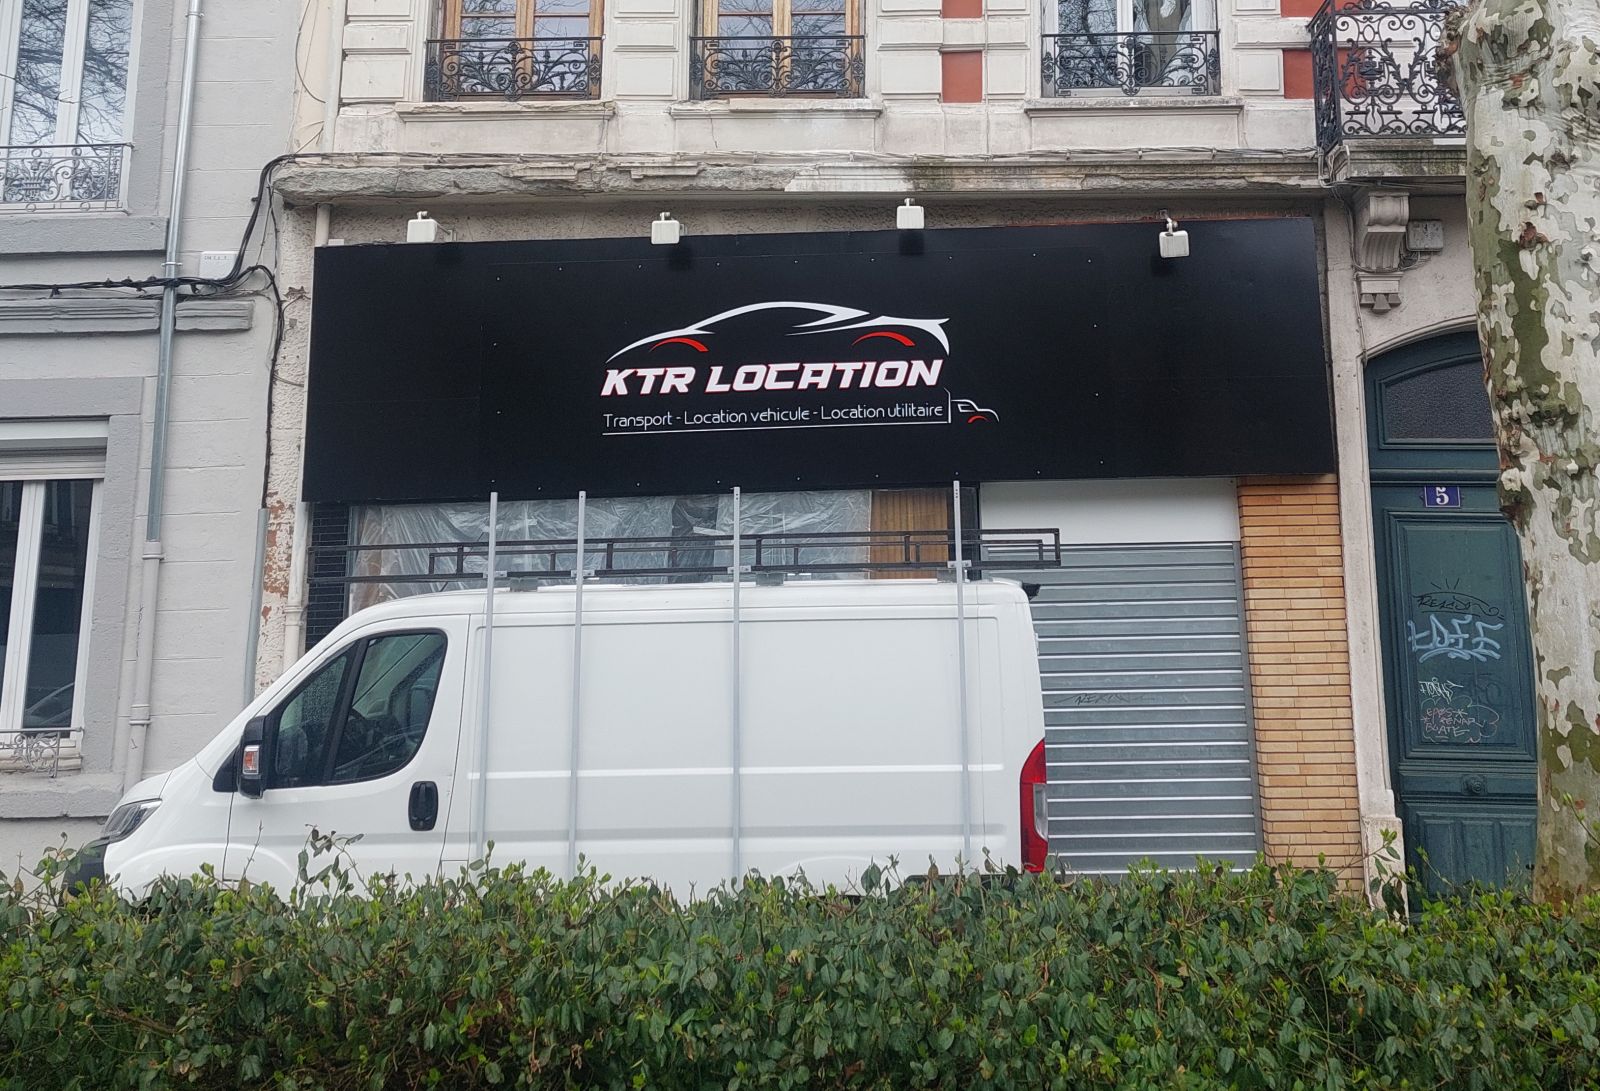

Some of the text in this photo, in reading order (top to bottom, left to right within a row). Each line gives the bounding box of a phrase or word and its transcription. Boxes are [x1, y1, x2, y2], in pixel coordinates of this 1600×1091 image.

[600, 358, 944, 397] KTR LOCATION
[603, 412, 673, 431] Transport
[684, 407, 748, 425] Location
[750, 406, 810, 422] vehicule
[820, 404, 885, 420] Location
[887, 402, 944, 418] utilitaire
[1435, 486, 1450, 505] 5
